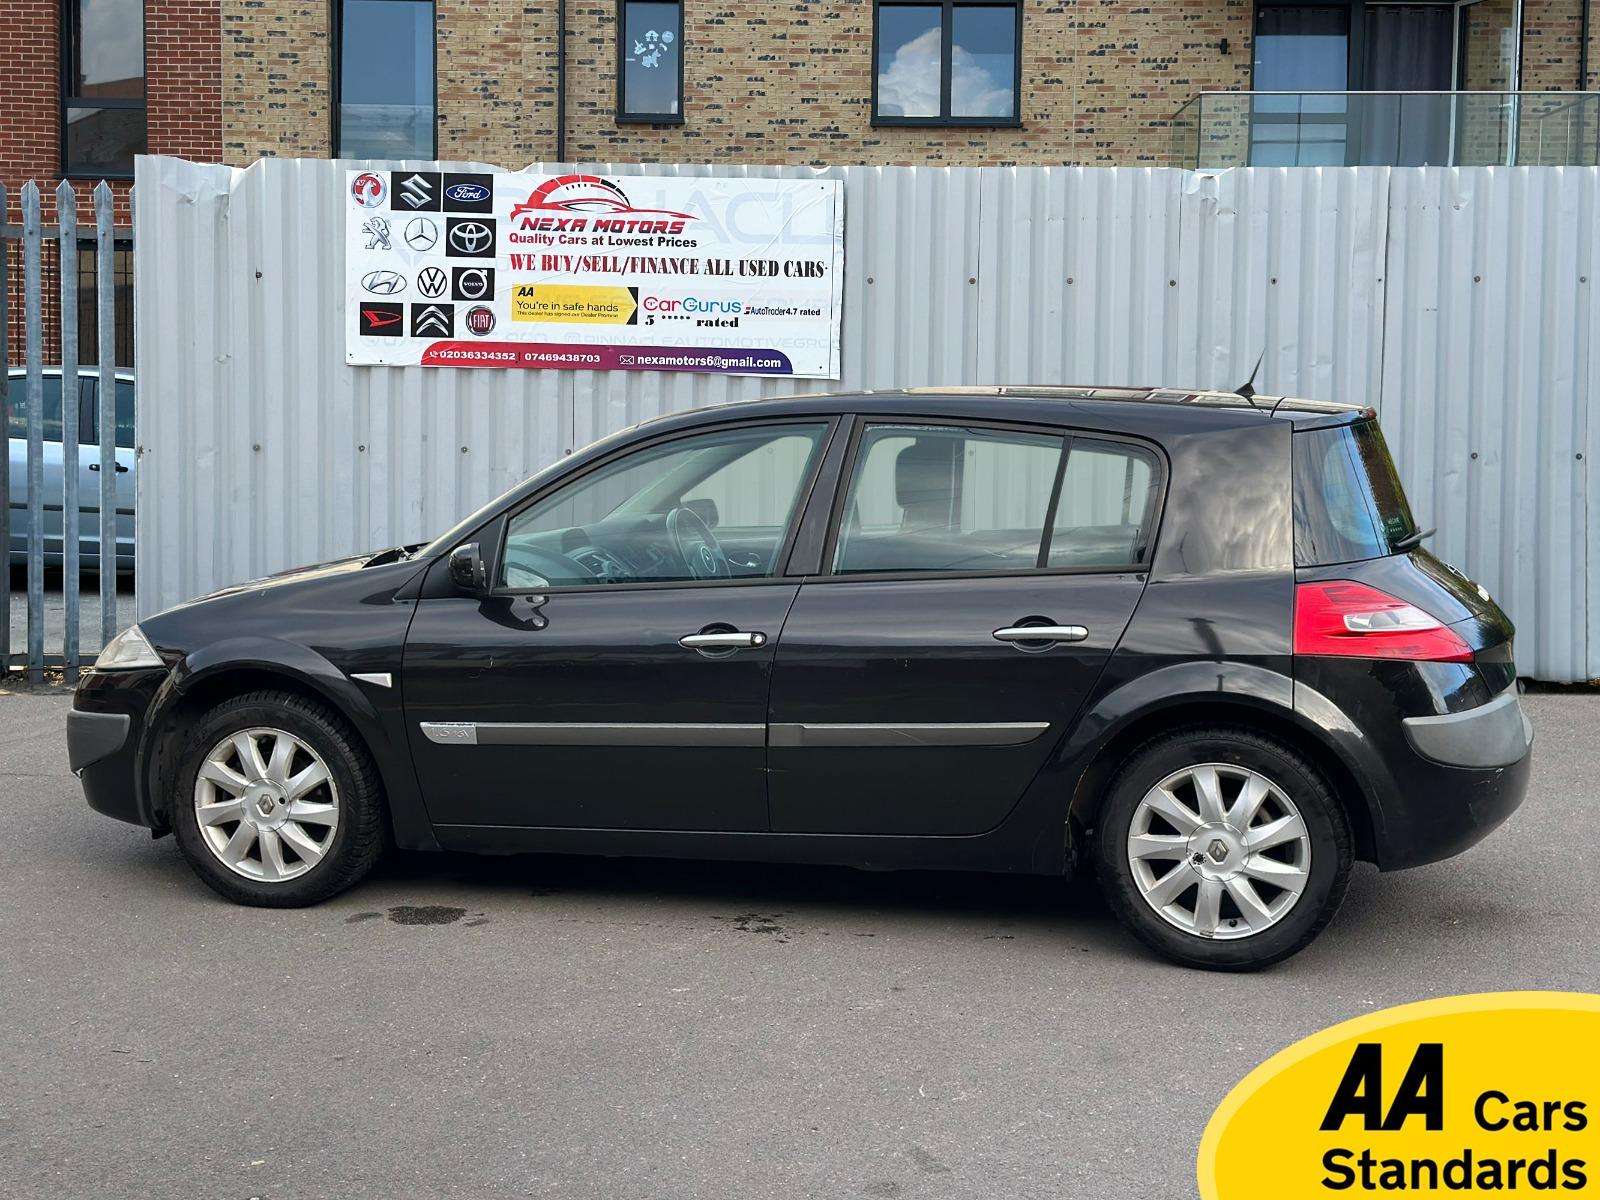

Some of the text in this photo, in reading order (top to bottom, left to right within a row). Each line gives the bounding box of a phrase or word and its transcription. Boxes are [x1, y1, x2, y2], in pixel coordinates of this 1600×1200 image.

[454, 186, 482, 199] Ford
[520, 217, 686, 235] NEXA MOTORS
[509, 232, 698, 248] Quality Cars at Lowest Prices
[509, 254, 536, 271] WE
[704, 258, 734, 276] ALL
[739, 259, 780, 277] USED
[783, 260, 826, 278] CARS
[517, 287, 534, 297] AA
[517, 301, 619, 312] You're in safe hands
[643, 297, 742, 313] CarGurus
[785, 307, 798, 316] 4.7
[799, 308, 821, 316] rated
[473, 314, 490, 328] FIAT
[645, 315, 739, 327] 5 rated
[637, 355, 781, 369] nexamotors6@gmail.com
